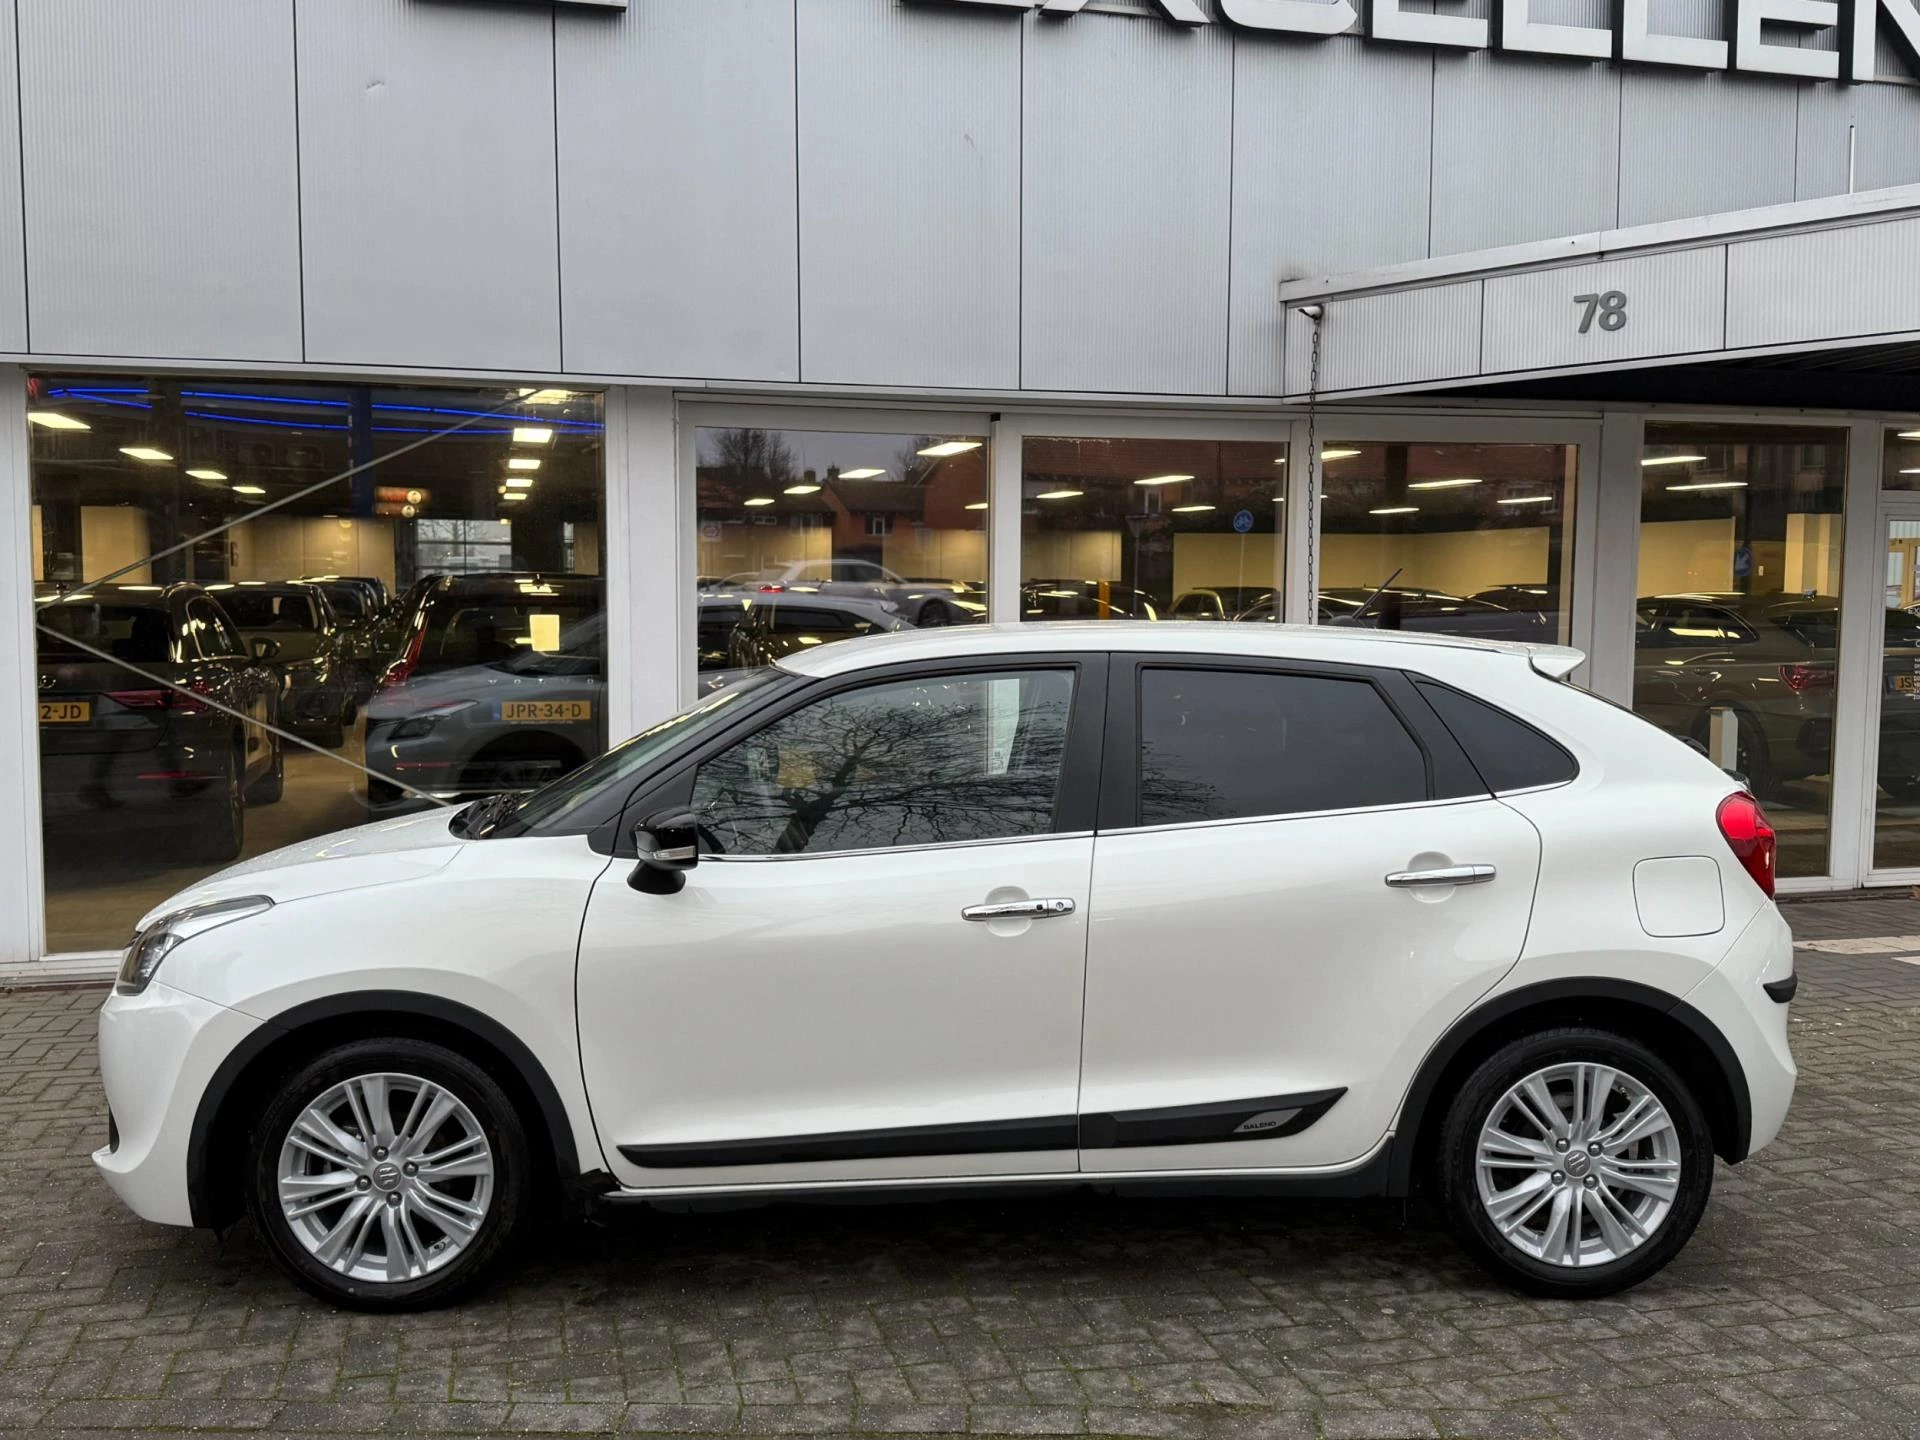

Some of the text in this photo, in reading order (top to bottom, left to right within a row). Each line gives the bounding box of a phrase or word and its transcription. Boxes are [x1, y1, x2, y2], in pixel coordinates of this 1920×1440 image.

[1573, 290, 1627, 334] 78
[507, 703, 583, 719] JPR-34-D
[1243, 1121, 1277, 1130] BALENO
